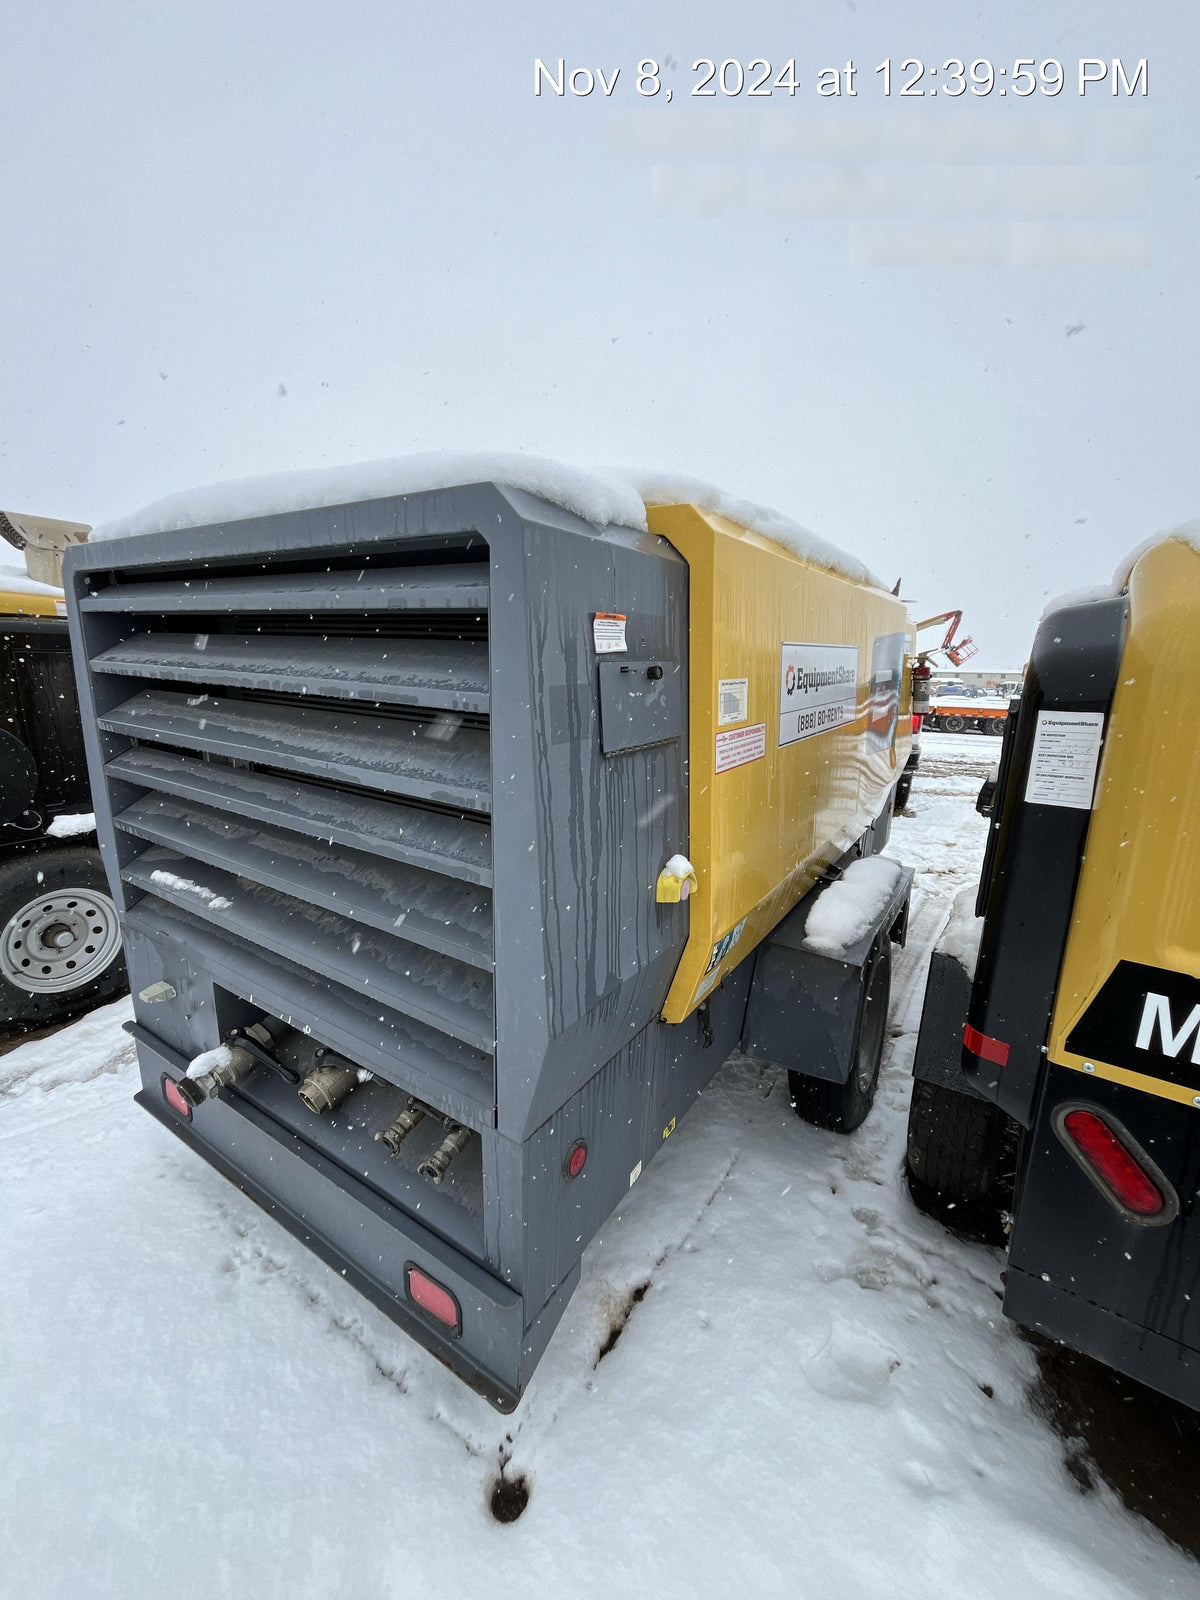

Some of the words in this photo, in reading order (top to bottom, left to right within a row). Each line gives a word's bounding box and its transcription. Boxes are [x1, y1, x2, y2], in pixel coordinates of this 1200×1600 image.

[797, 666, 855, 693] EquipmentShare
[797, 711, 816, 733] (888)
[818, 706, 844, 726] 80-RENTS
[1135, 991, 1200, 1066] M
